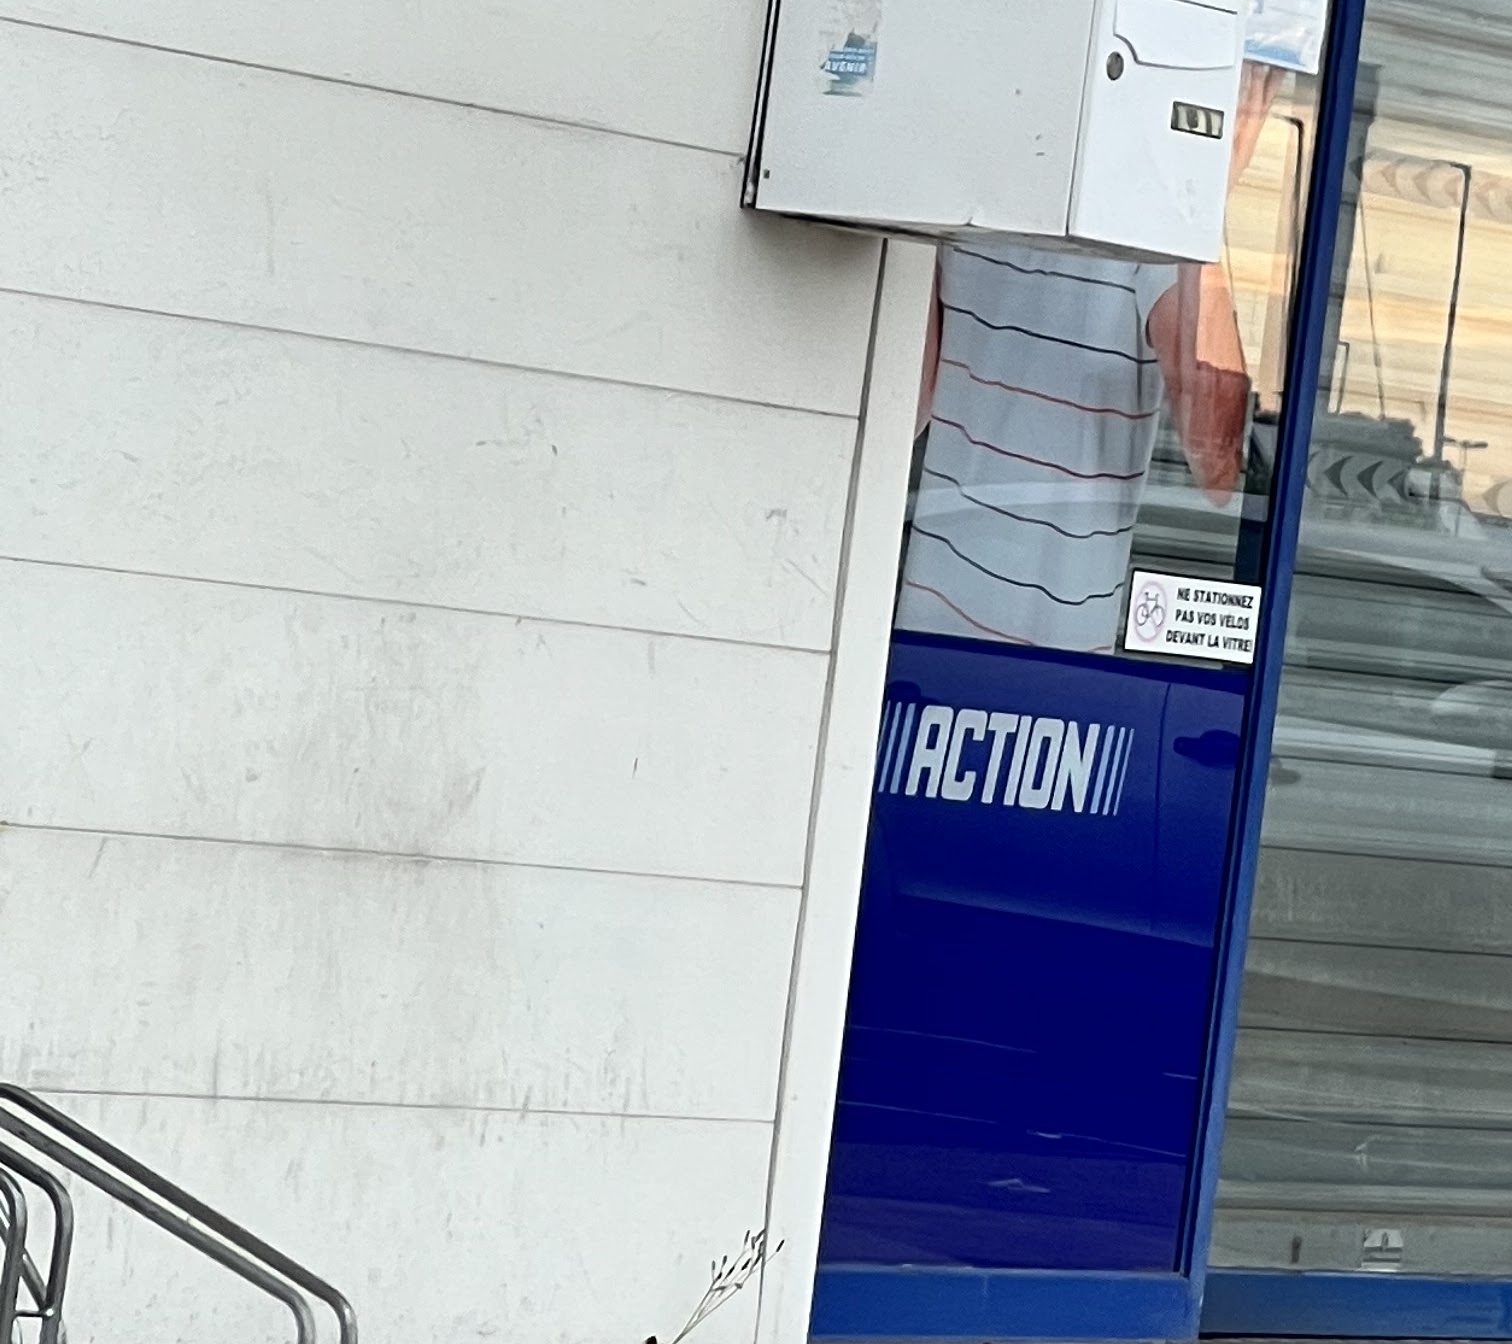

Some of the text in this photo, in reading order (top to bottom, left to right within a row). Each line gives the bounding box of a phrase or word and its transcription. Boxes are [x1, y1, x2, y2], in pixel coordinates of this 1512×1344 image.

[1177, 588, 1253, 608] NE STATIONNEZ
[1176, 609, 1194, 623] PAS
[1198, 612, 1216, 625] VOS
[1166, 630, 1205, 645] DEVANT
[1208, 635, 1219, 648] LA
[904, 704, 1101, 813] ACTION
